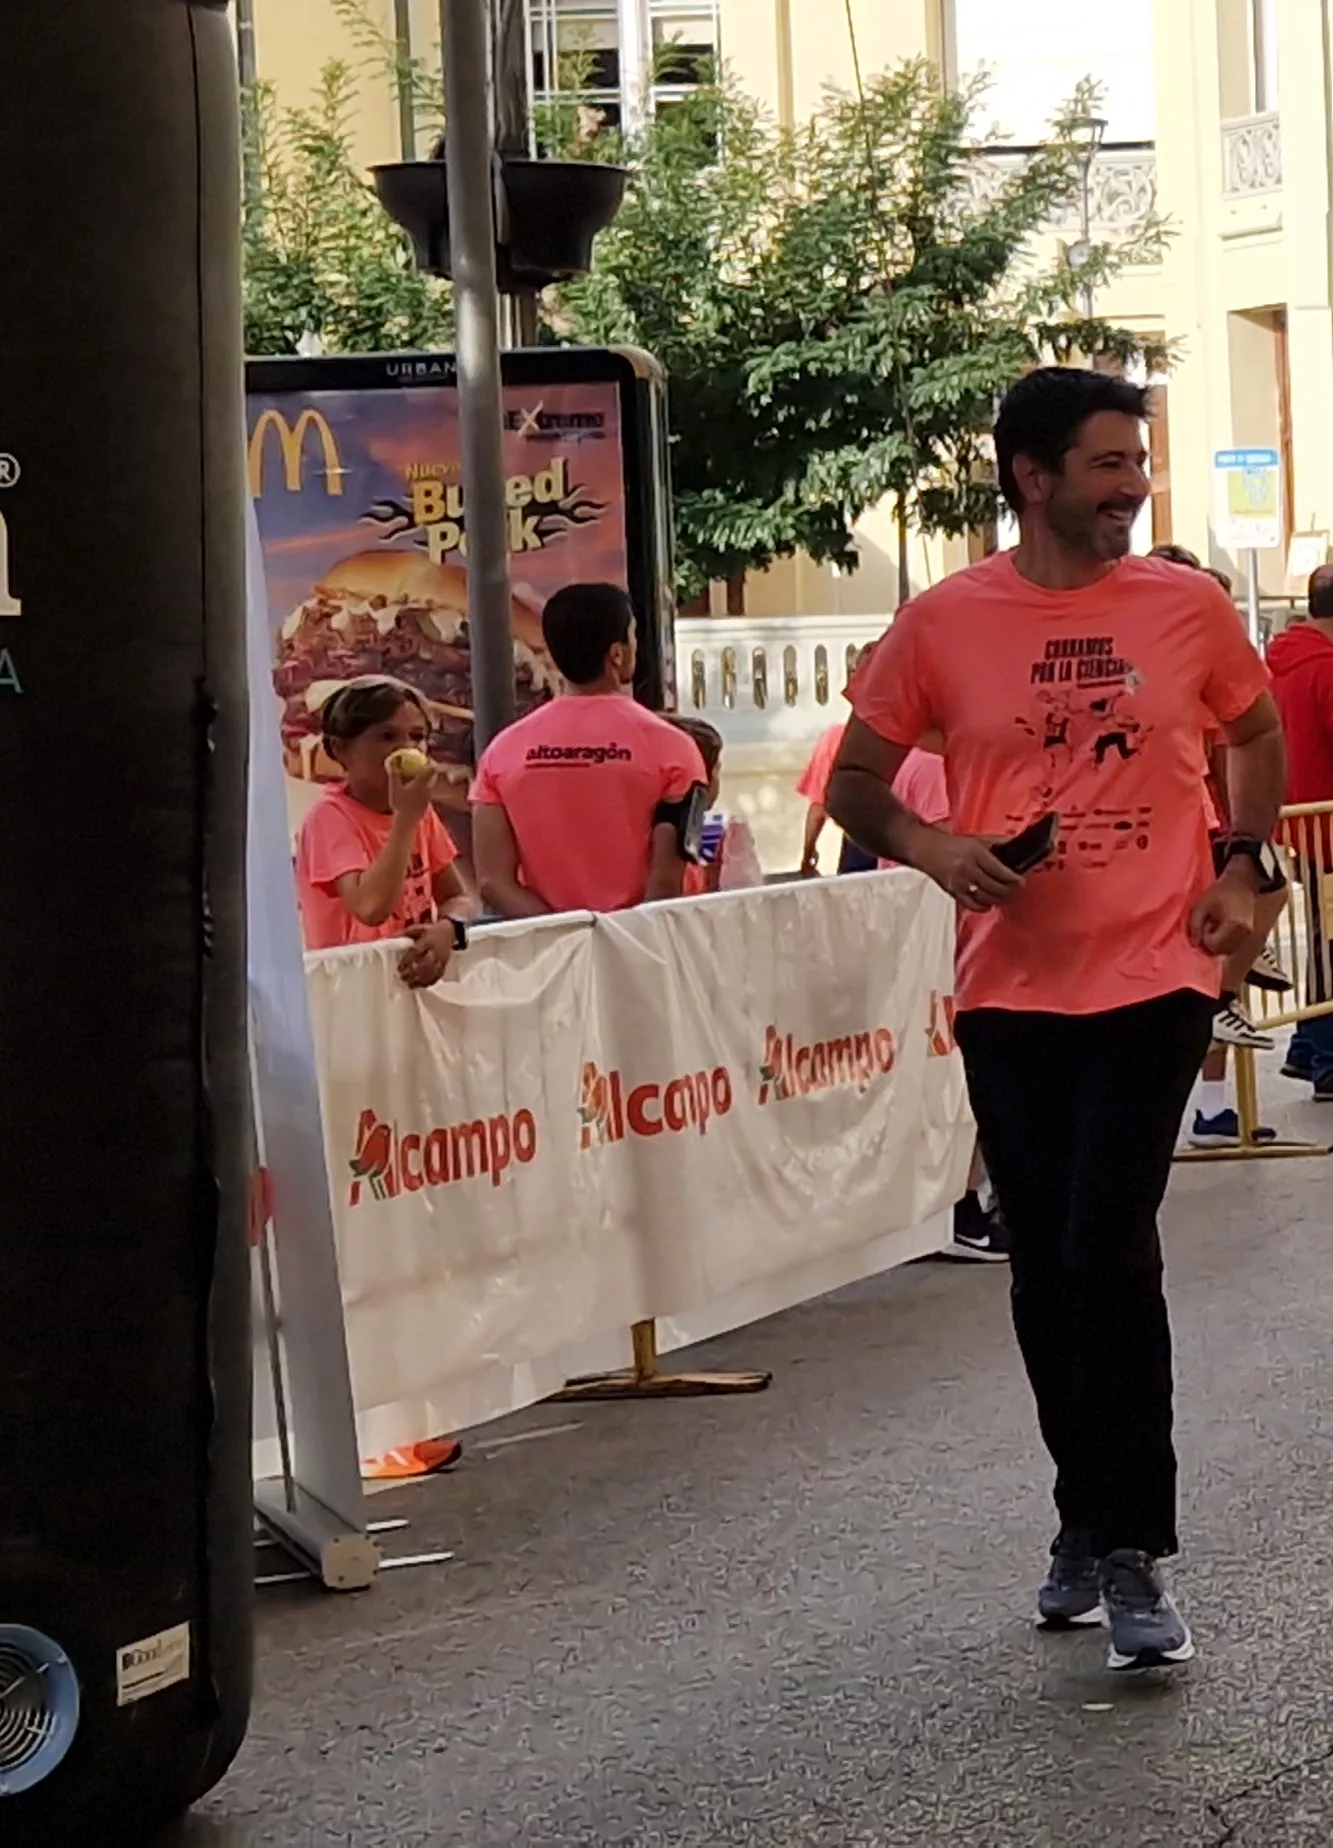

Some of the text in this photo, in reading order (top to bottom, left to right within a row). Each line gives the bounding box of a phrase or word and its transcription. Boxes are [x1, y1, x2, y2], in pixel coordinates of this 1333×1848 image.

[526, 742, 632, 764] altoaragón
[757, 1024, 895, 1105] Alcampo
[349, 1109, 537, 1207] Alcampo
